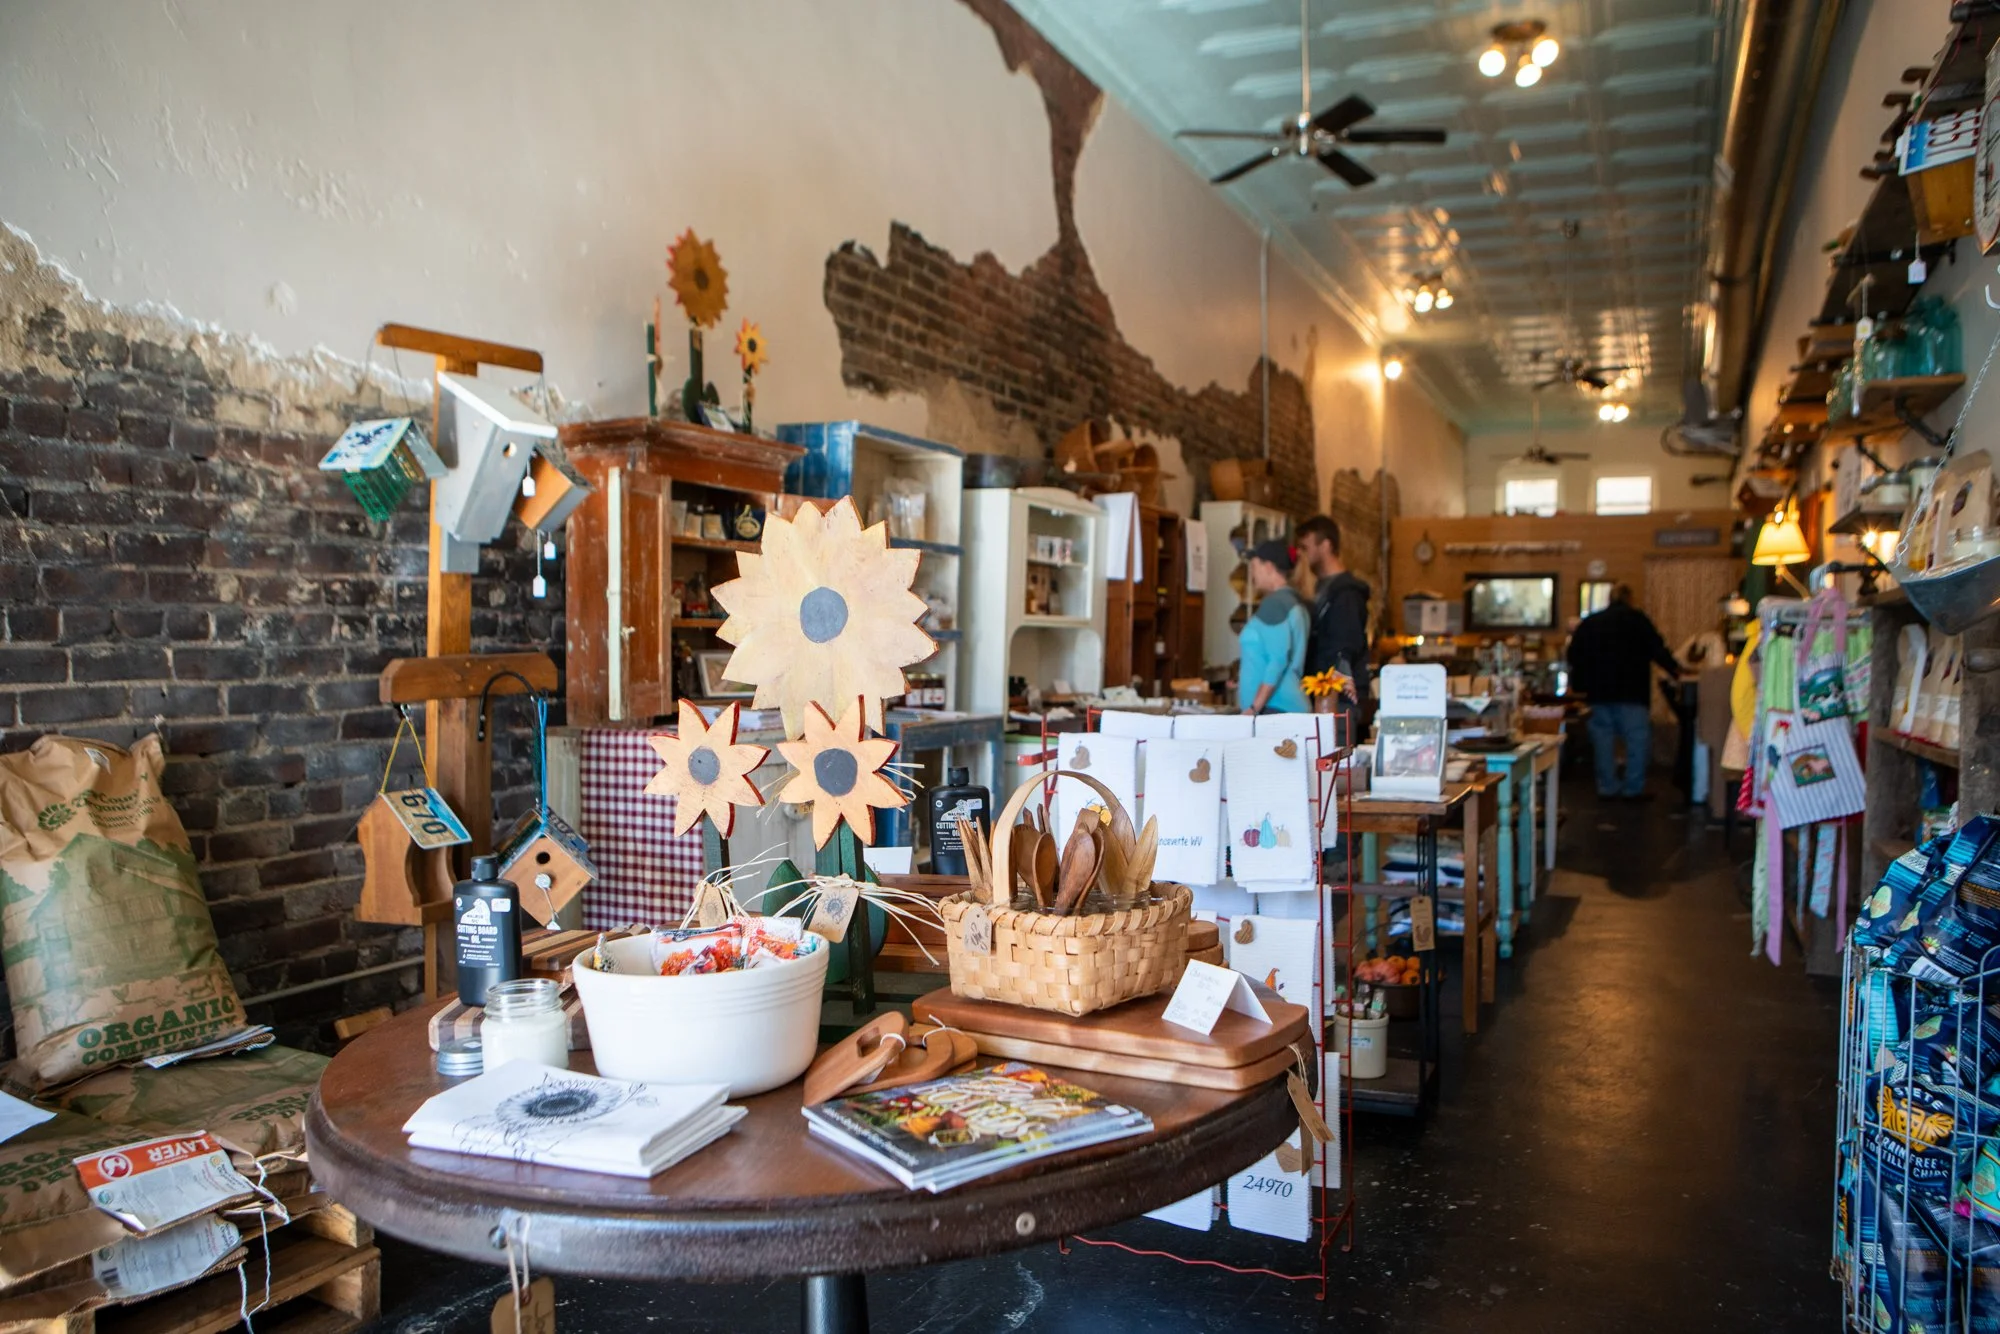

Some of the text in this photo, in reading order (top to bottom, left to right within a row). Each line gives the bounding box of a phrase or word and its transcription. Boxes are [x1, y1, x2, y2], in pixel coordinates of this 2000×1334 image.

[478, 926, 498, 935] BOARD
[77, 995, 236, 1049] ORGANIC
[82, 1015, 238, 1065] COMMUNITY
[147, 1138, 210, 1162] LAYER
[1909, 1153, 1938, 1169] FREE
[1242, 1174, 1293, 1198] 24970
